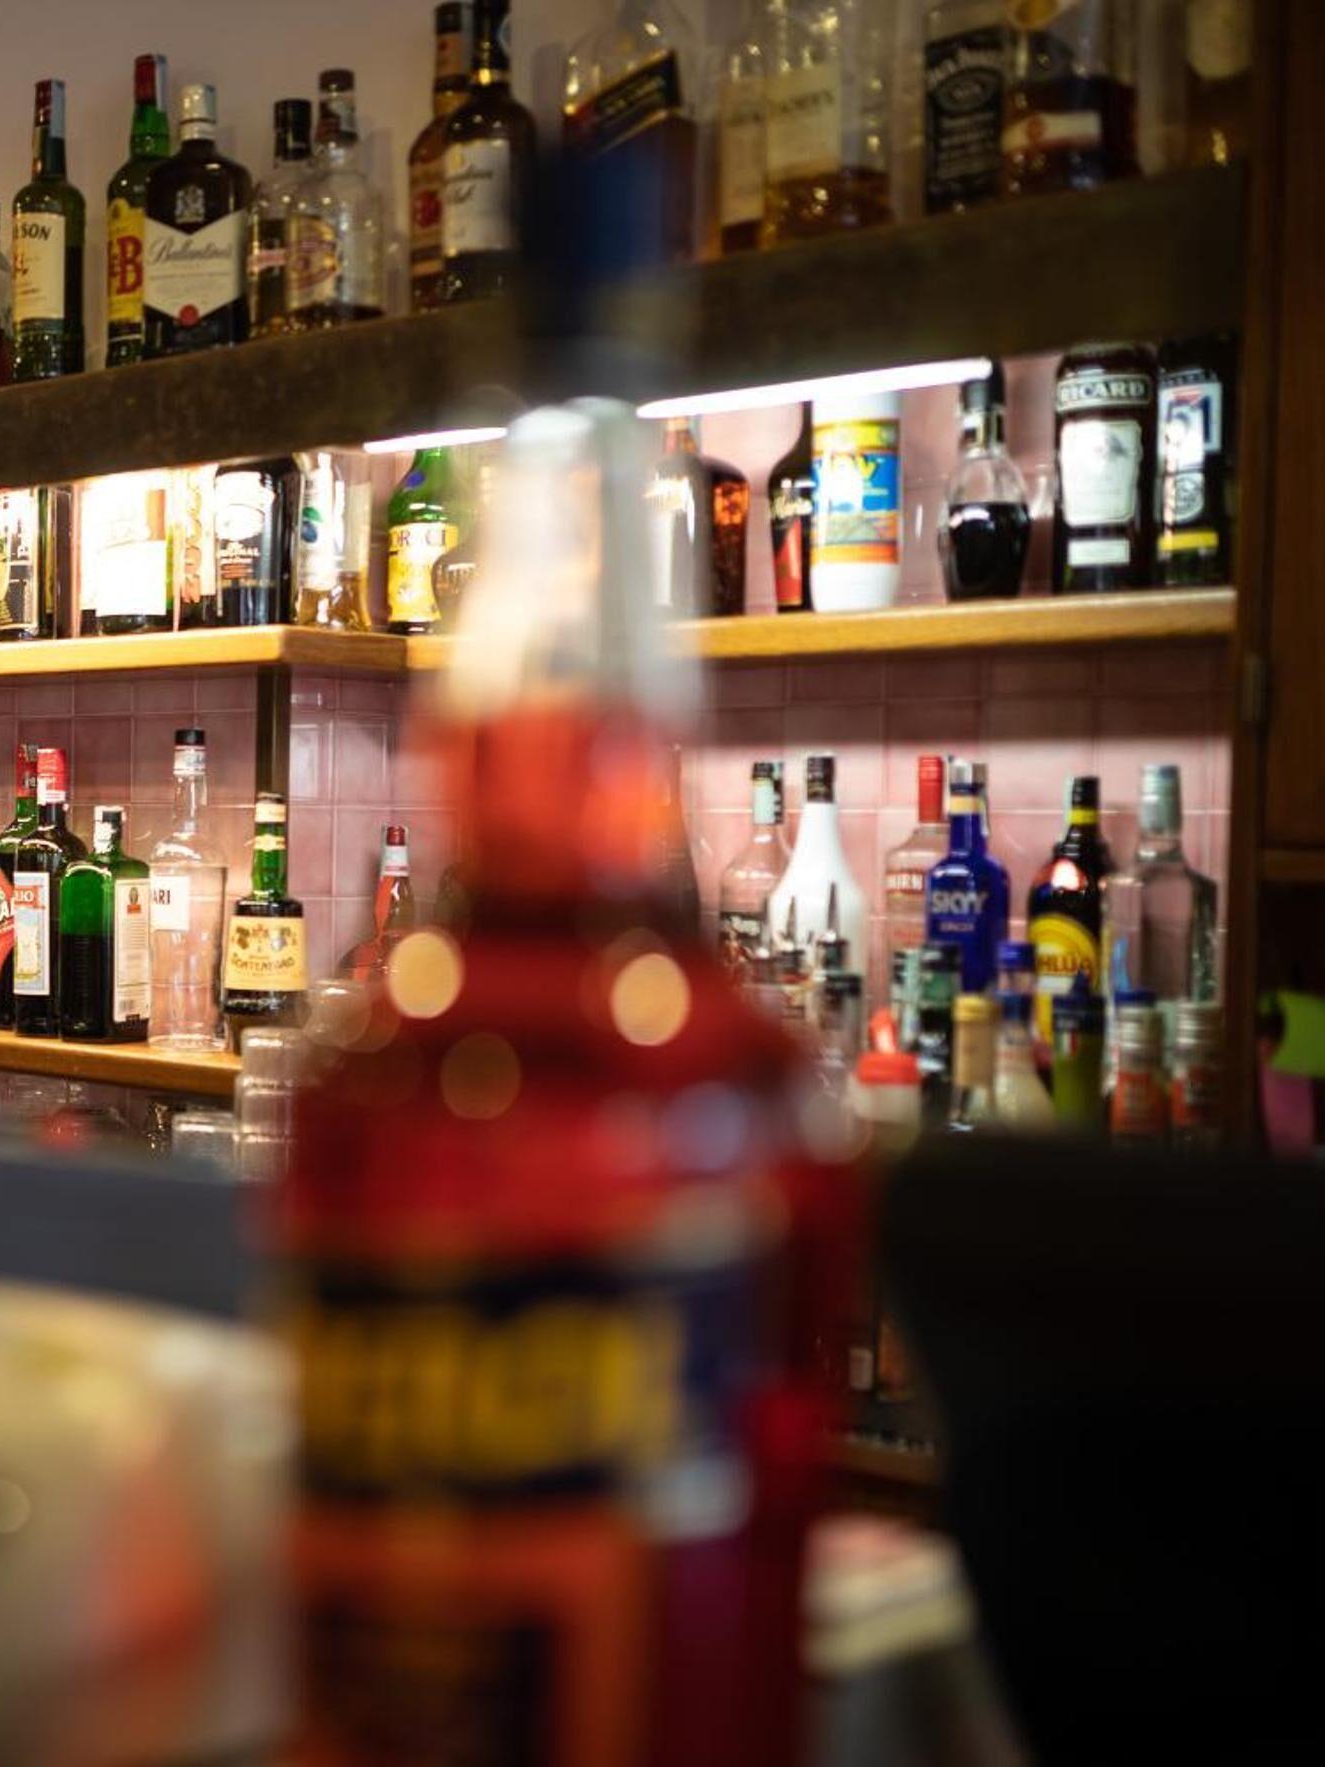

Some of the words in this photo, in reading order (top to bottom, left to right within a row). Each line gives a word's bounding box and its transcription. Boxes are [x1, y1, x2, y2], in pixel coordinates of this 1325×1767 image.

[15, 222, 52, 240] SON
[1061, 378, 1145, 402] RICARD
[931, 890, 990, 914] SKYY
